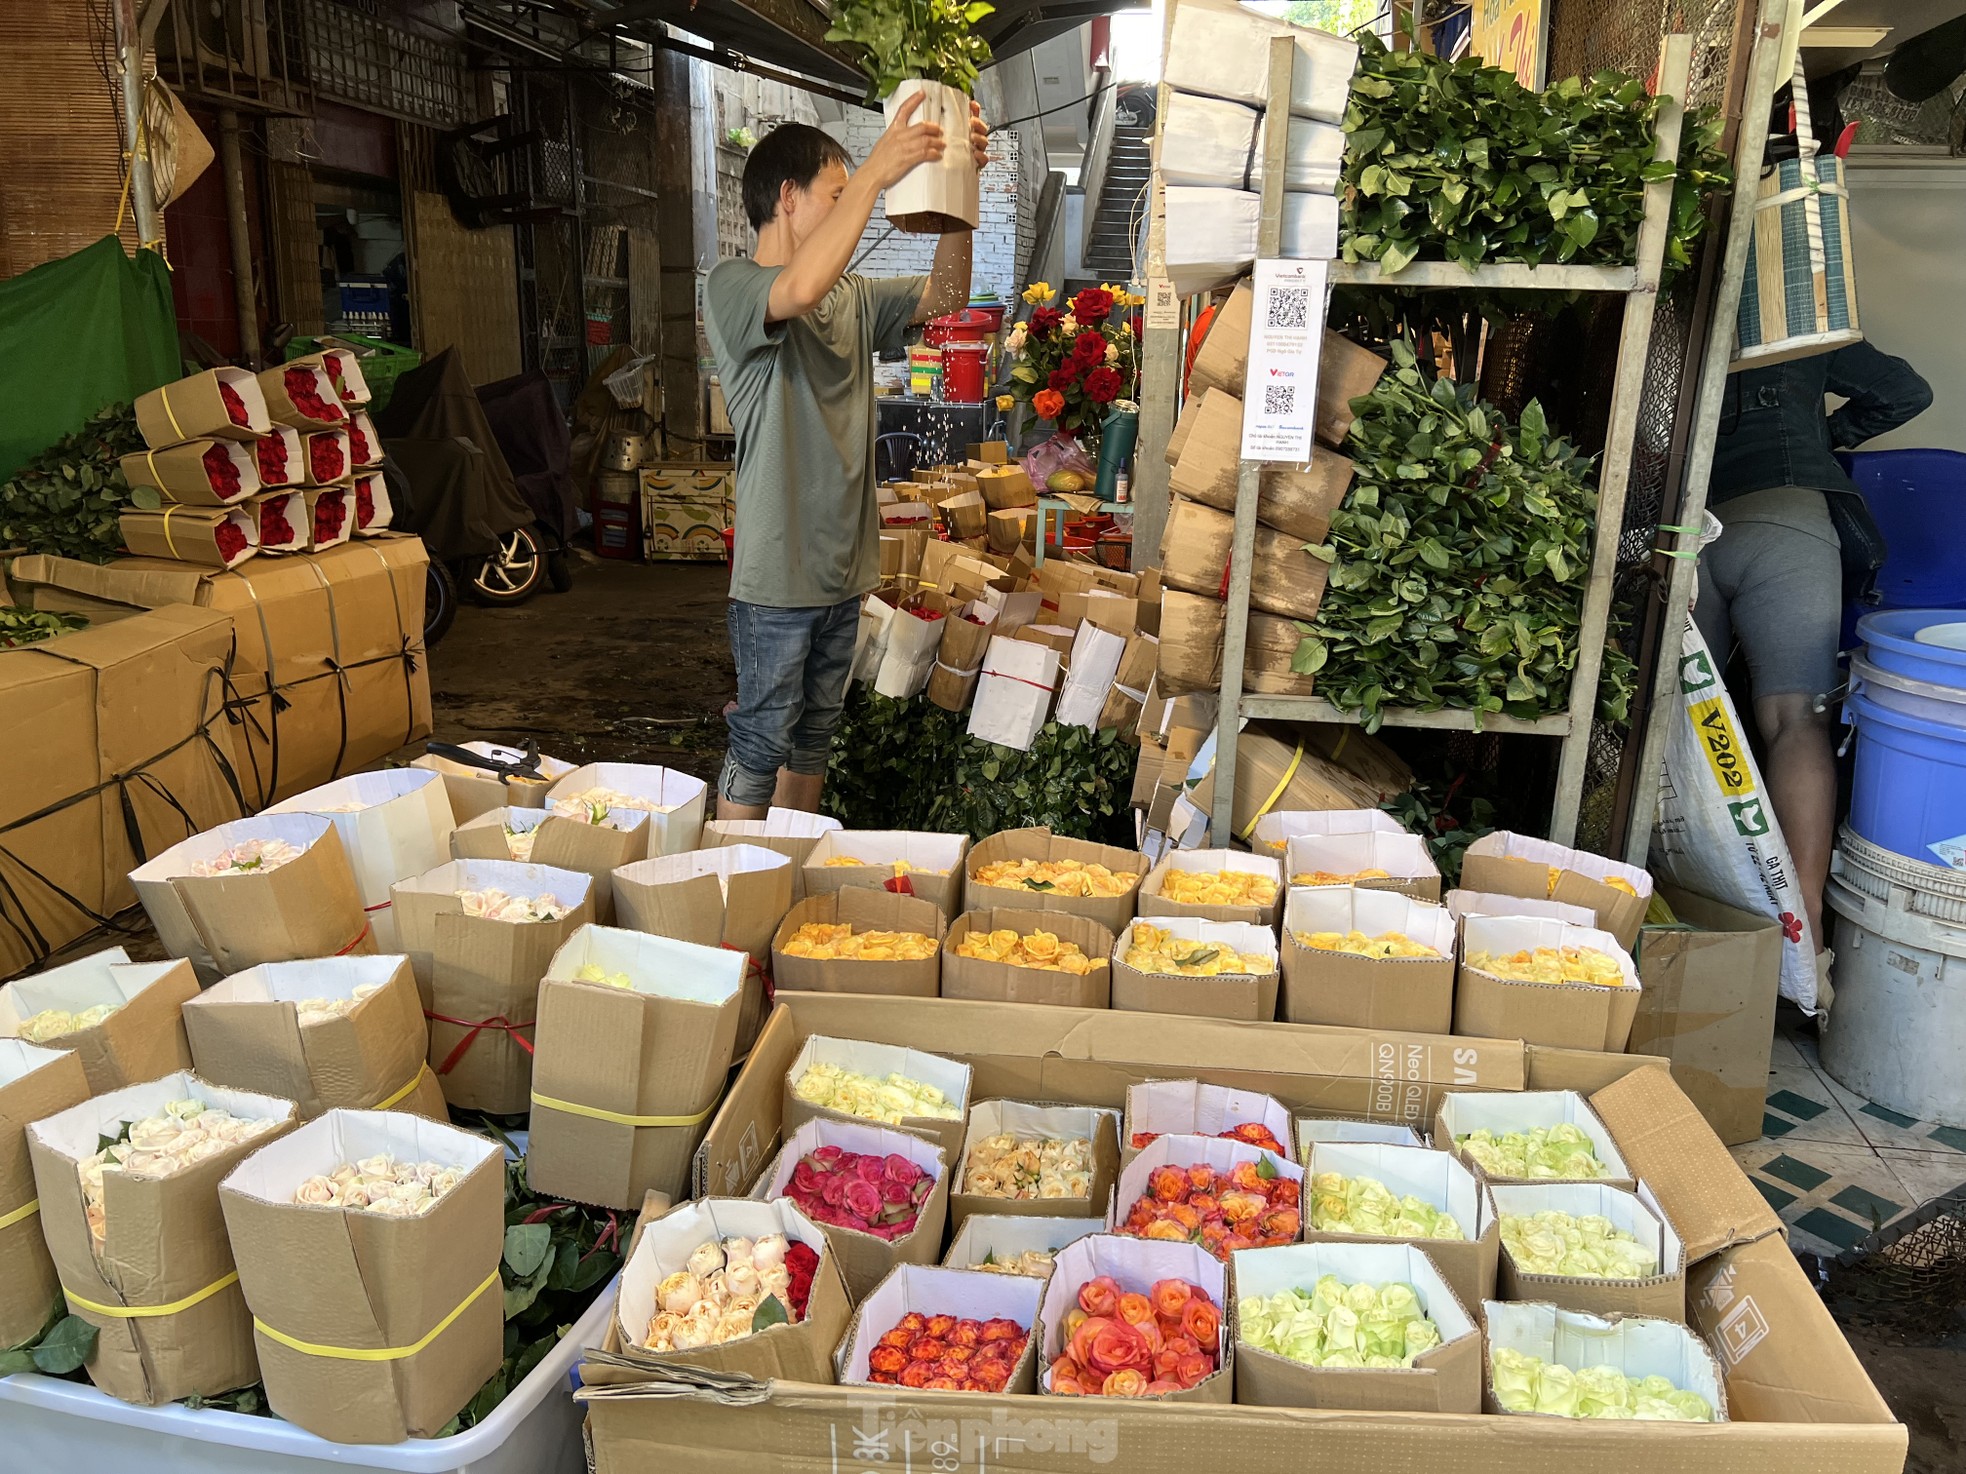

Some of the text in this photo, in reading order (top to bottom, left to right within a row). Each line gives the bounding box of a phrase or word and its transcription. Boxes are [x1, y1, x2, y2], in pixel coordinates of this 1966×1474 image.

[1701, 707, 1743, 788] V202
[1765, 856, 1789, 890] GÀ THỊT
[1376, 1043, 1394, 1112] QN900B
[1404, 1045, 1423, 1120] Neo QLED
[852, 1426, 889, 1464] 8K
